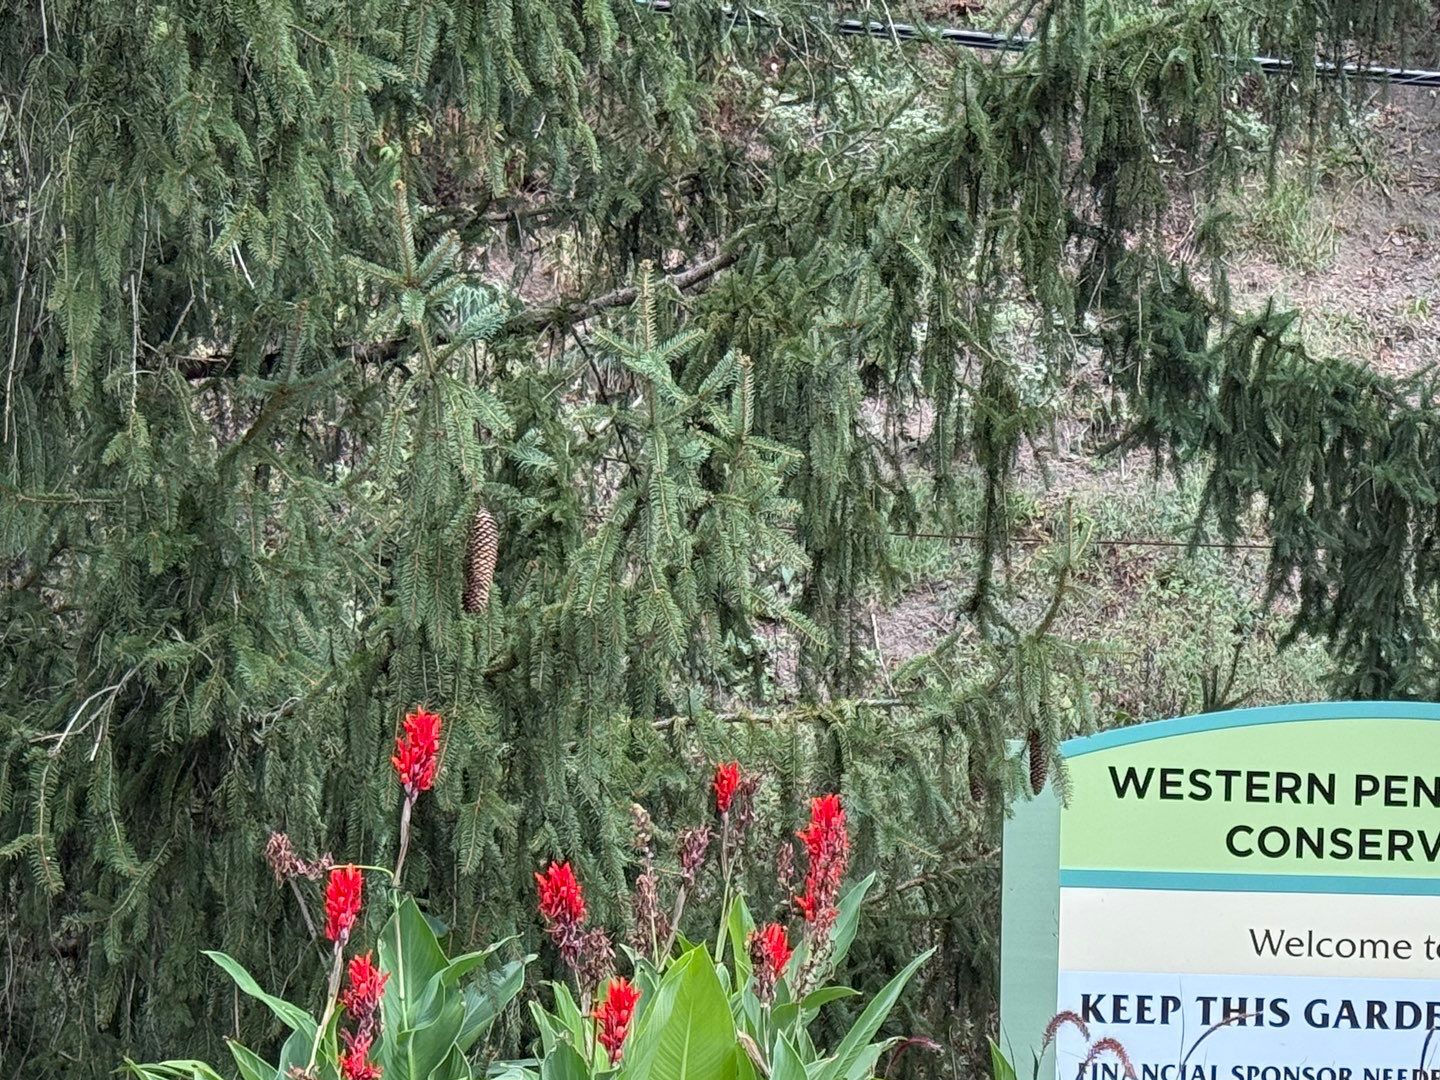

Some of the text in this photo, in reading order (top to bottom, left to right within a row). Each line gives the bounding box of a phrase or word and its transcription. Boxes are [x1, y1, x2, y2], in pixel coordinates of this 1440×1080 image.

[1108, 765, 1337, 806] WESTERN
[1248, 928, 1412, 962] Welcome
[1080, 993, 1181, 1026] KEEP
[1195, 996, 1290, 1029] THIS
